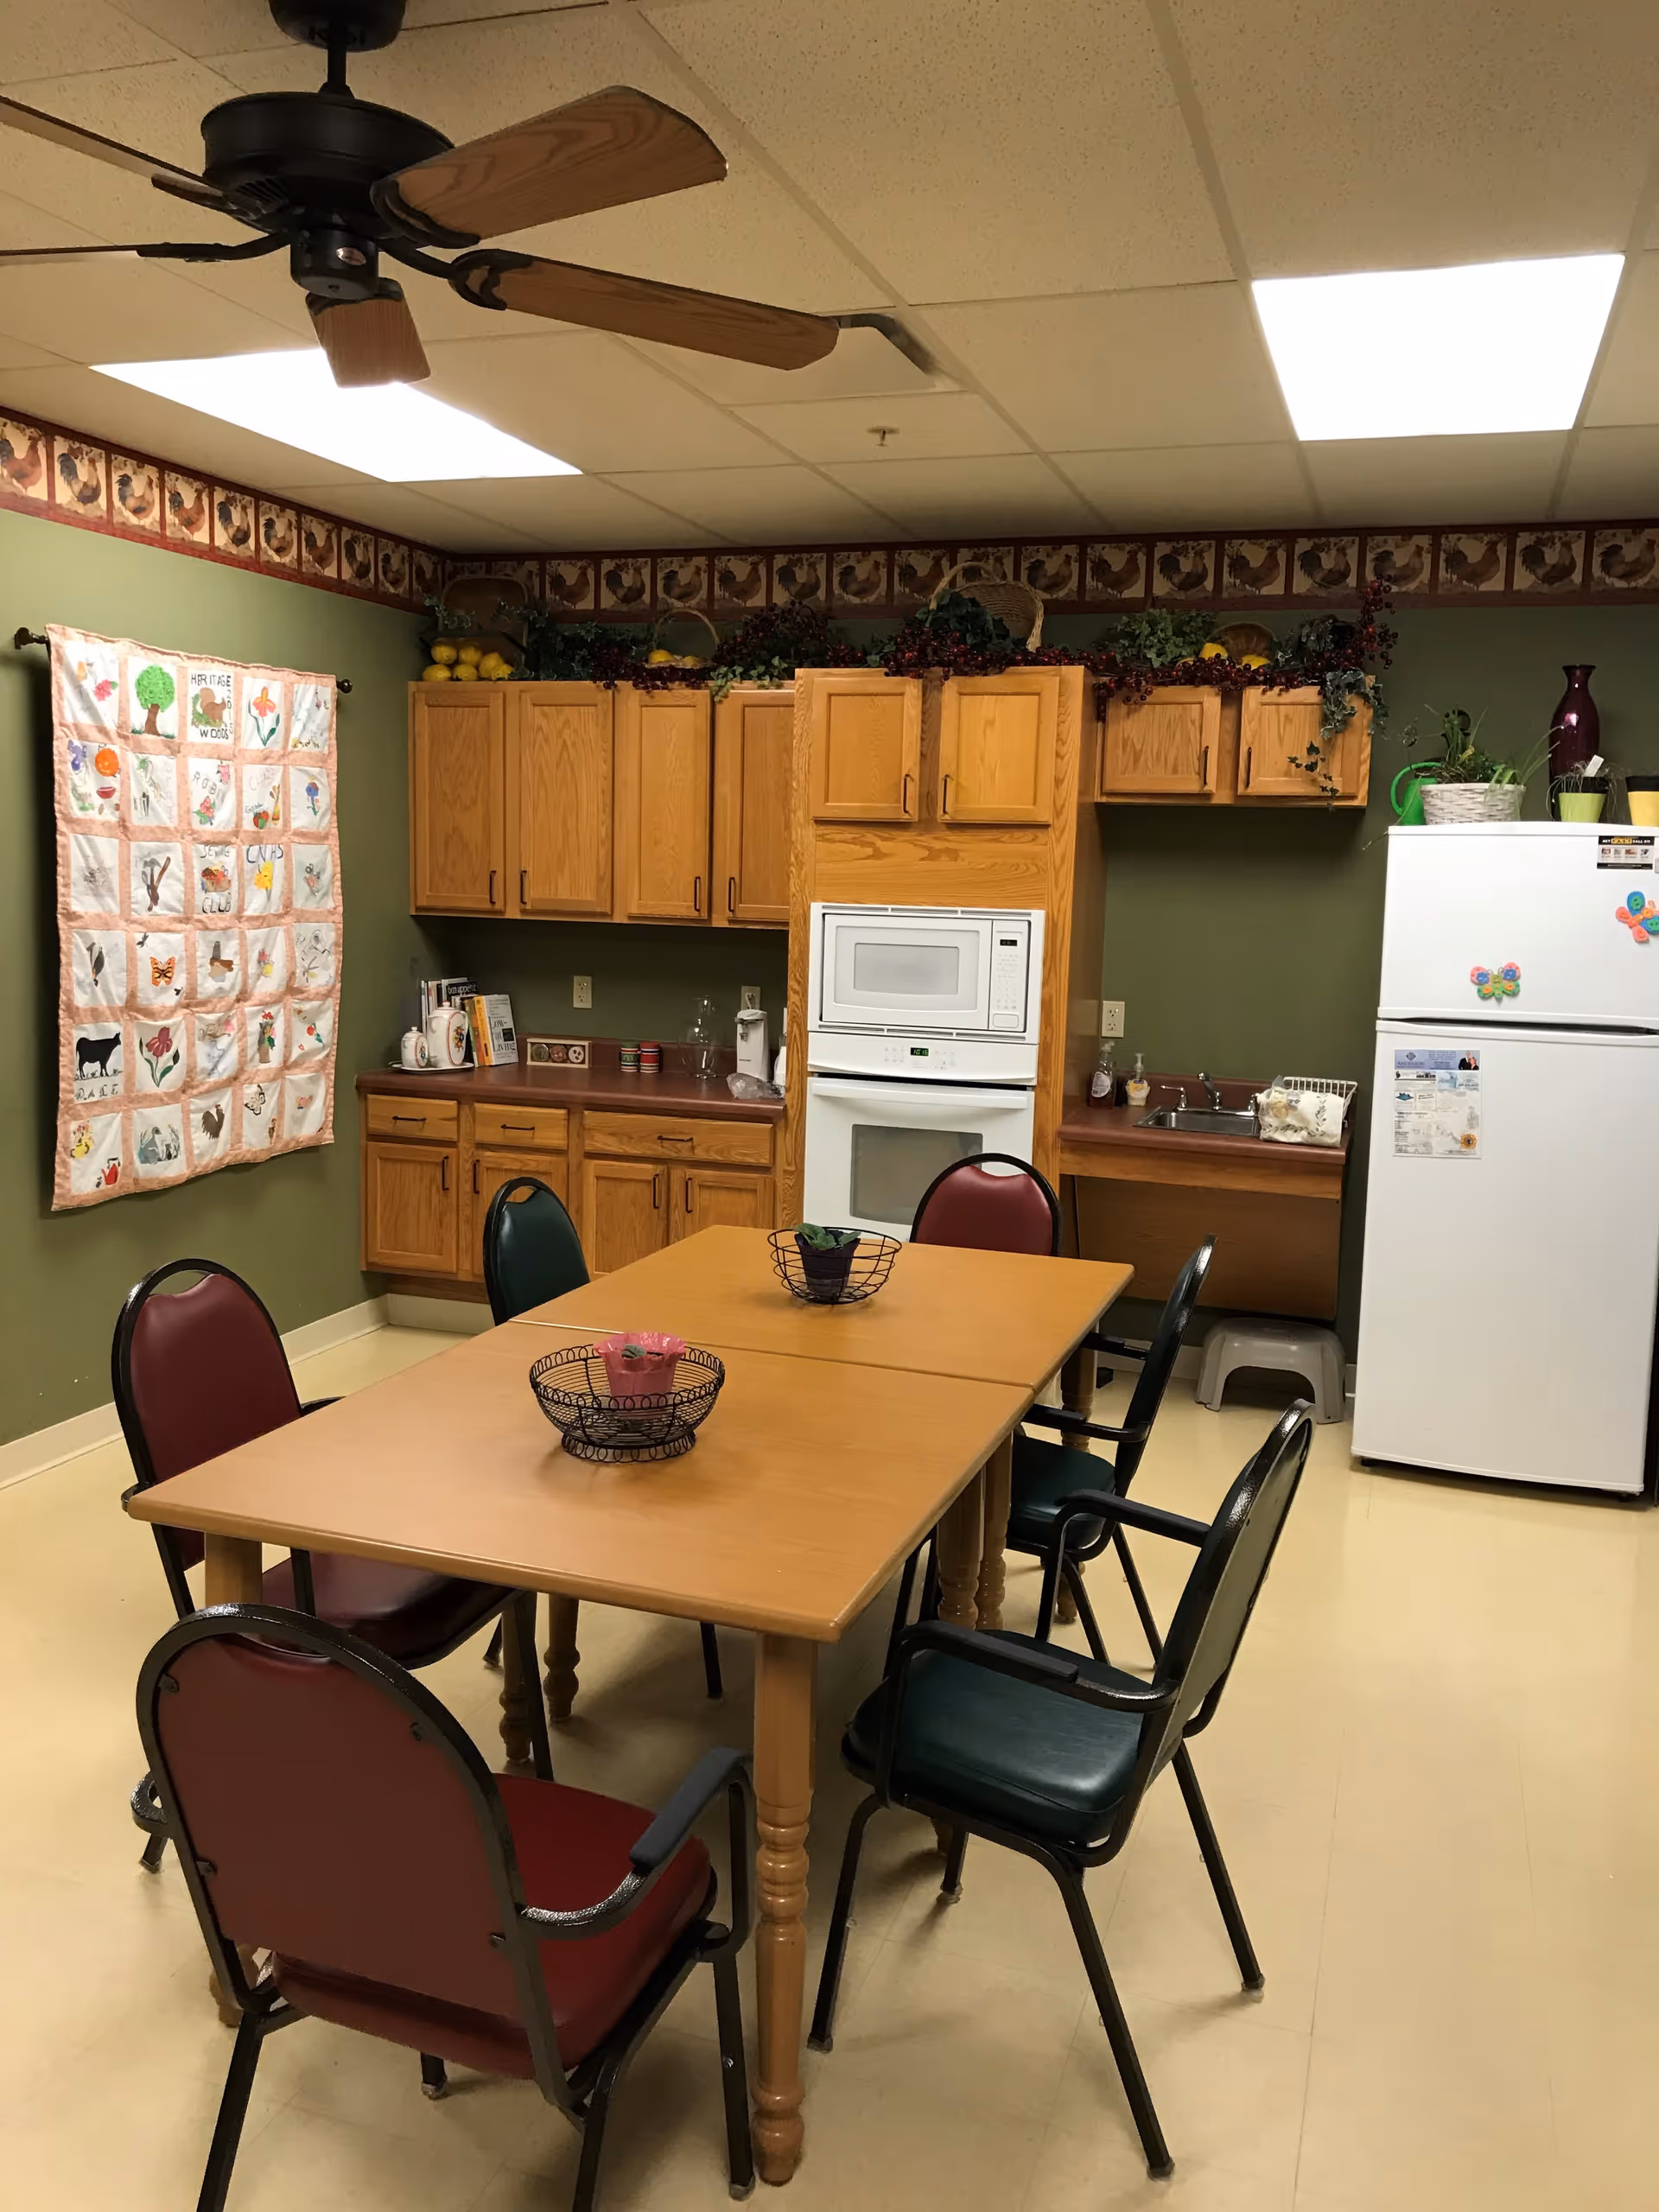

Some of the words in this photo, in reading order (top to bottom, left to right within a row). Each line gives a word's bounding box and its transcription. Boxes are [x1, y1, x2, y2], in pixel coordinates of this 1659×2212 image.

[191, 673, 232, 687] HERITAGE
[200, 728, 229, 740] WOODS
[201, 892, 232, 913] CLUB
